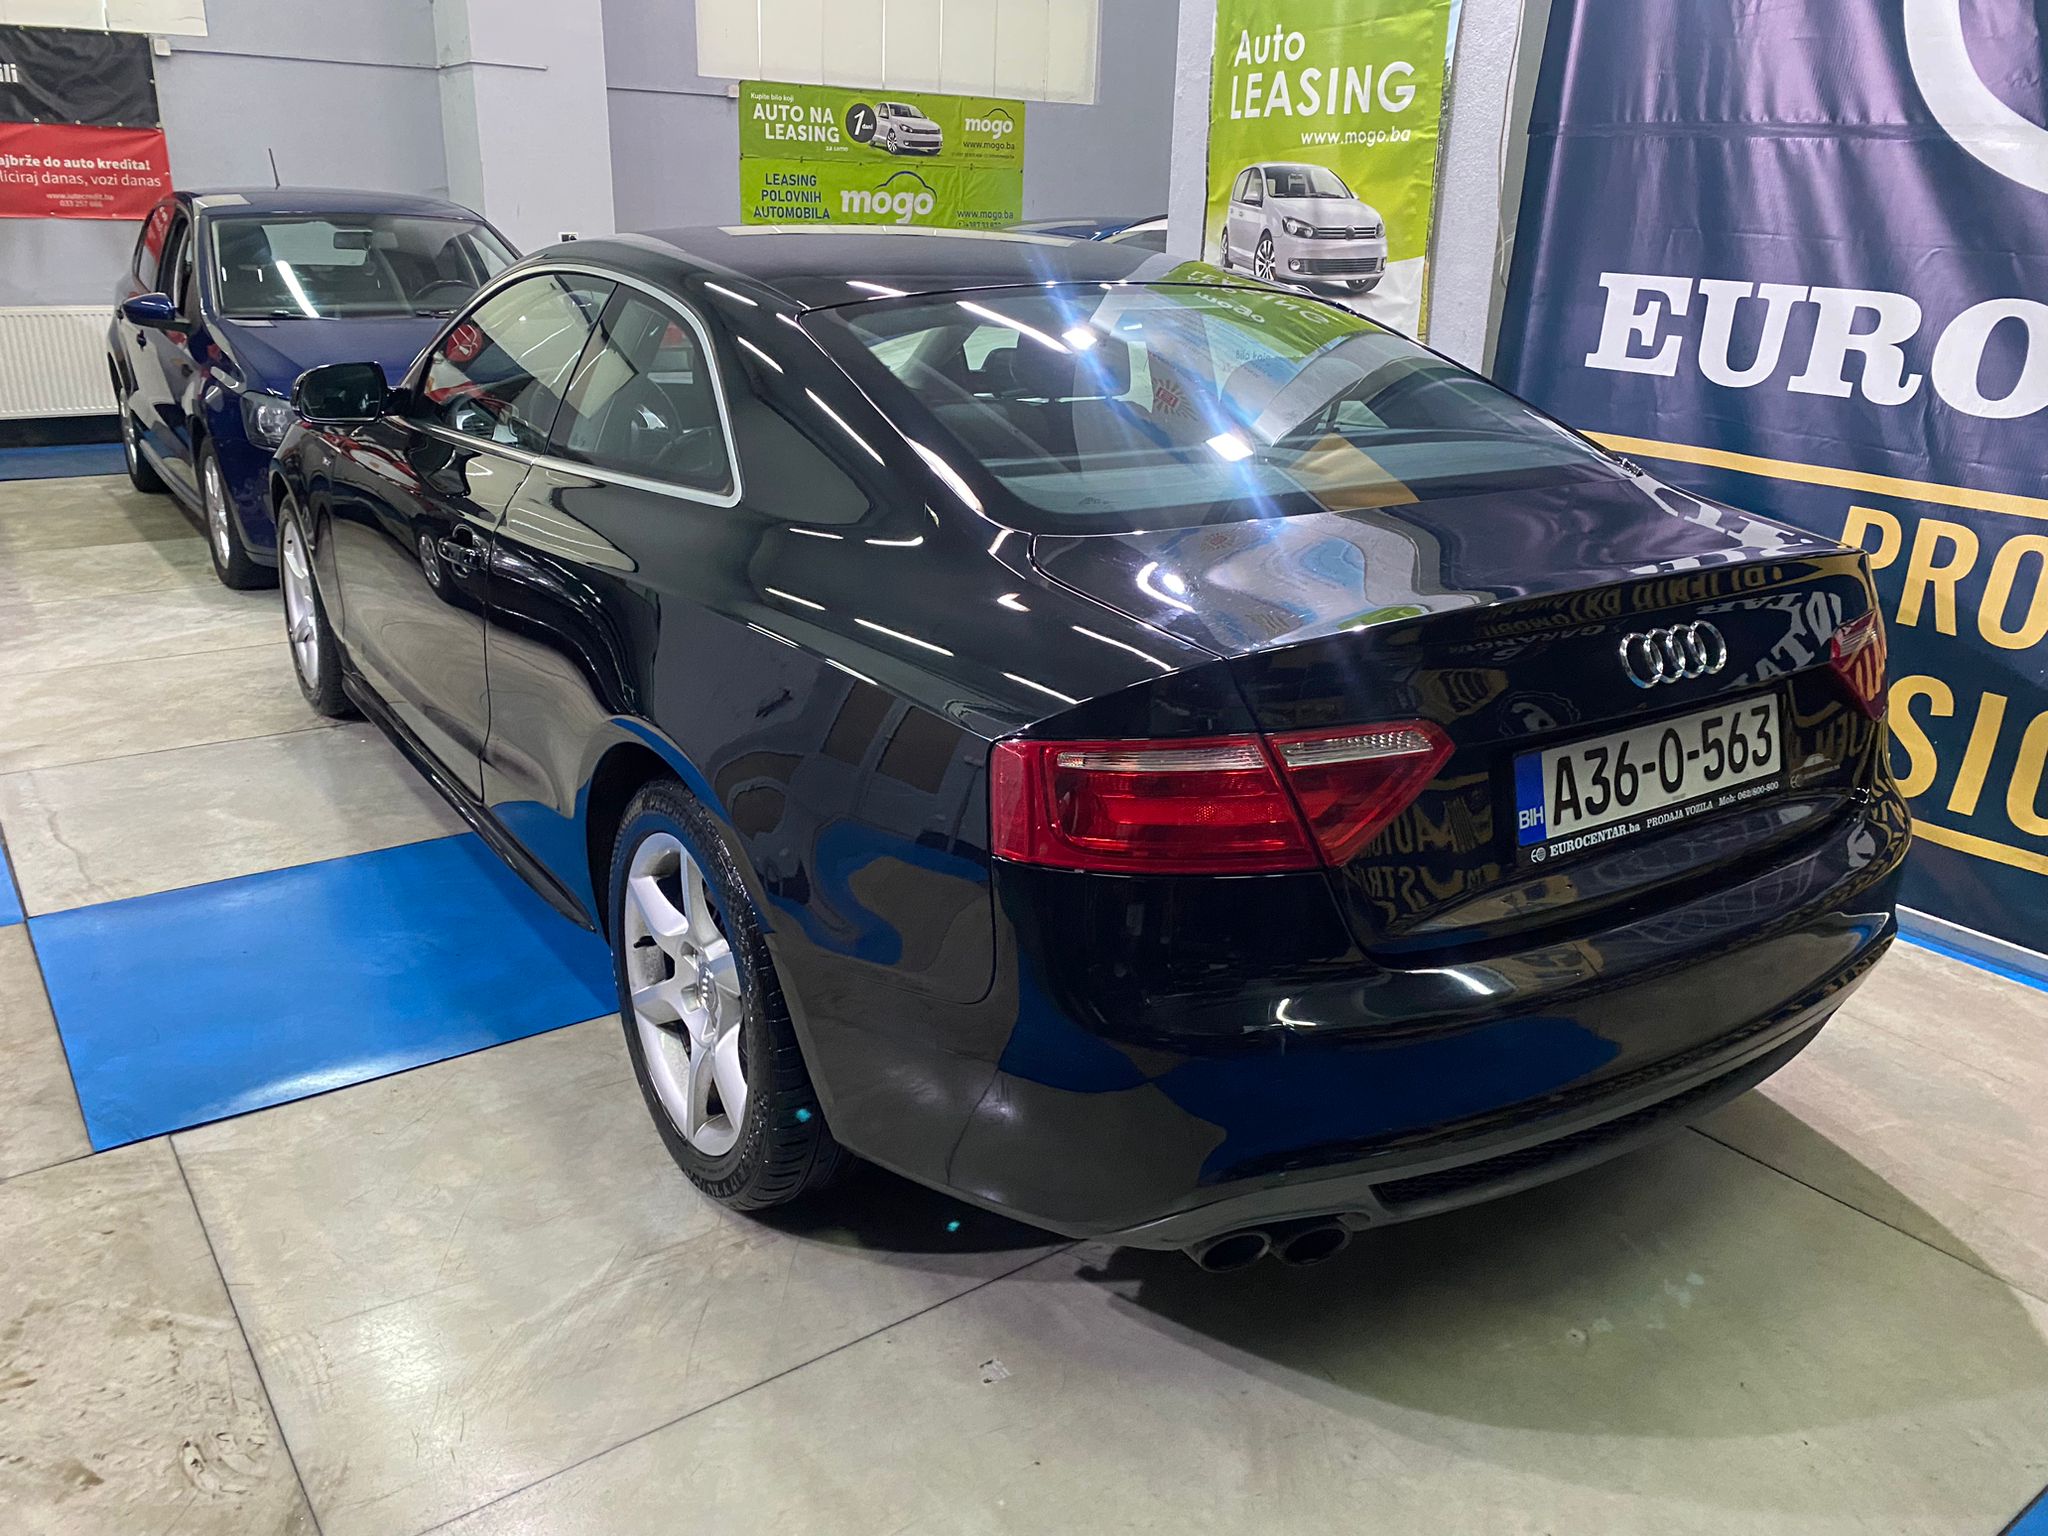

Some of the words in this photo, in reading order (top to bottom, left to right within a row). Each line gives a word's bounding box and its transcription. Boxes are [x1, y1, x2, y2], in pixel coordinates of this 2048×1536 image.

[1234, 23, 1306, 67] Auto
[750, 92, 770, 101] Kupite
[783, 95, 794, 103] koji
[1230, 61, 1416, 120] LEASING
[753, 103, 804, 122] AUTO
[809, 106, 835, 124] NA
[854, 109, 866, 136] 1
[765, 123, 840, 143] LEASING
[965, 118, 1013, 139] mogo
[1301, 125, 1412, 147] www.mogo.ba
[963, 141, 1015, 151] www.mogo.ba
[43, 156, 61, 167] do
[63, 158, 95, 169] auto
[96, 157, 151, 171] kredita!
[41, 171, 88, 187] danas,
[90, 174, 118, 186] vozi
[120, 174, 162, 188] danas
[765, 173, 817, 187] LEASING
[761, 189, 822, 203] POLOVNIH
[753, 206, 830, 219] AUTOMOBILA
[840, 190, 934, 224] mogo
[957, 210, 1013, 220] www.mogo.ba
[1585, 272, 2048, 418] EURO
[1841, 505, 2048, 650] PRO
[1519, 806, 1545, 829] BIH
[1549, 822, 1641, 857] EUROCENTAR.ba
[1646, 808, 1684, 828] PRODAJA
[1685, 800, 1714, 816] VOZILA
[1718, 794, 1737, 807] Mob:
